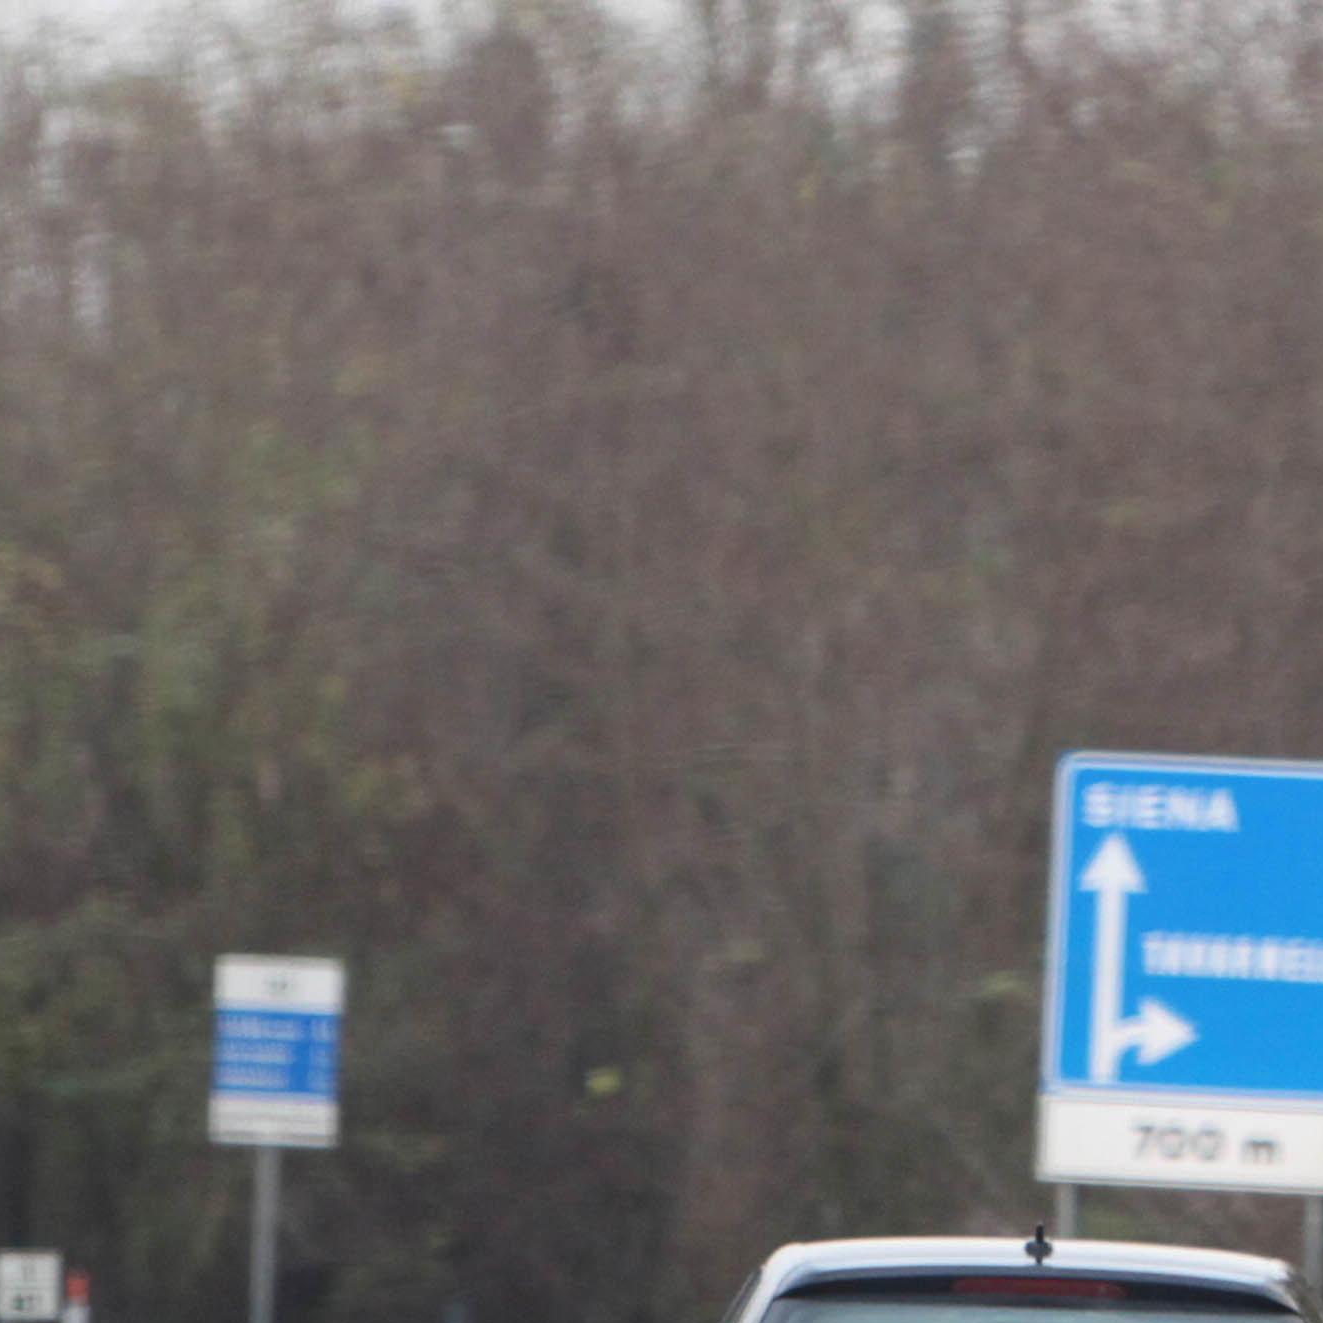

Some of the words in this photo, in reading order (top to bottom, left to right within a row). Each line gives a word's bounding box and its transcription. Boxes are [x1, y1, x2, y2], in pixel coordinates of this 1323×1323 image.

[1082, 783, 1239, 832] SIENA
[1131, 1123, 1226, 1163] 700
[1241, 1135, 1280, 1165] m
